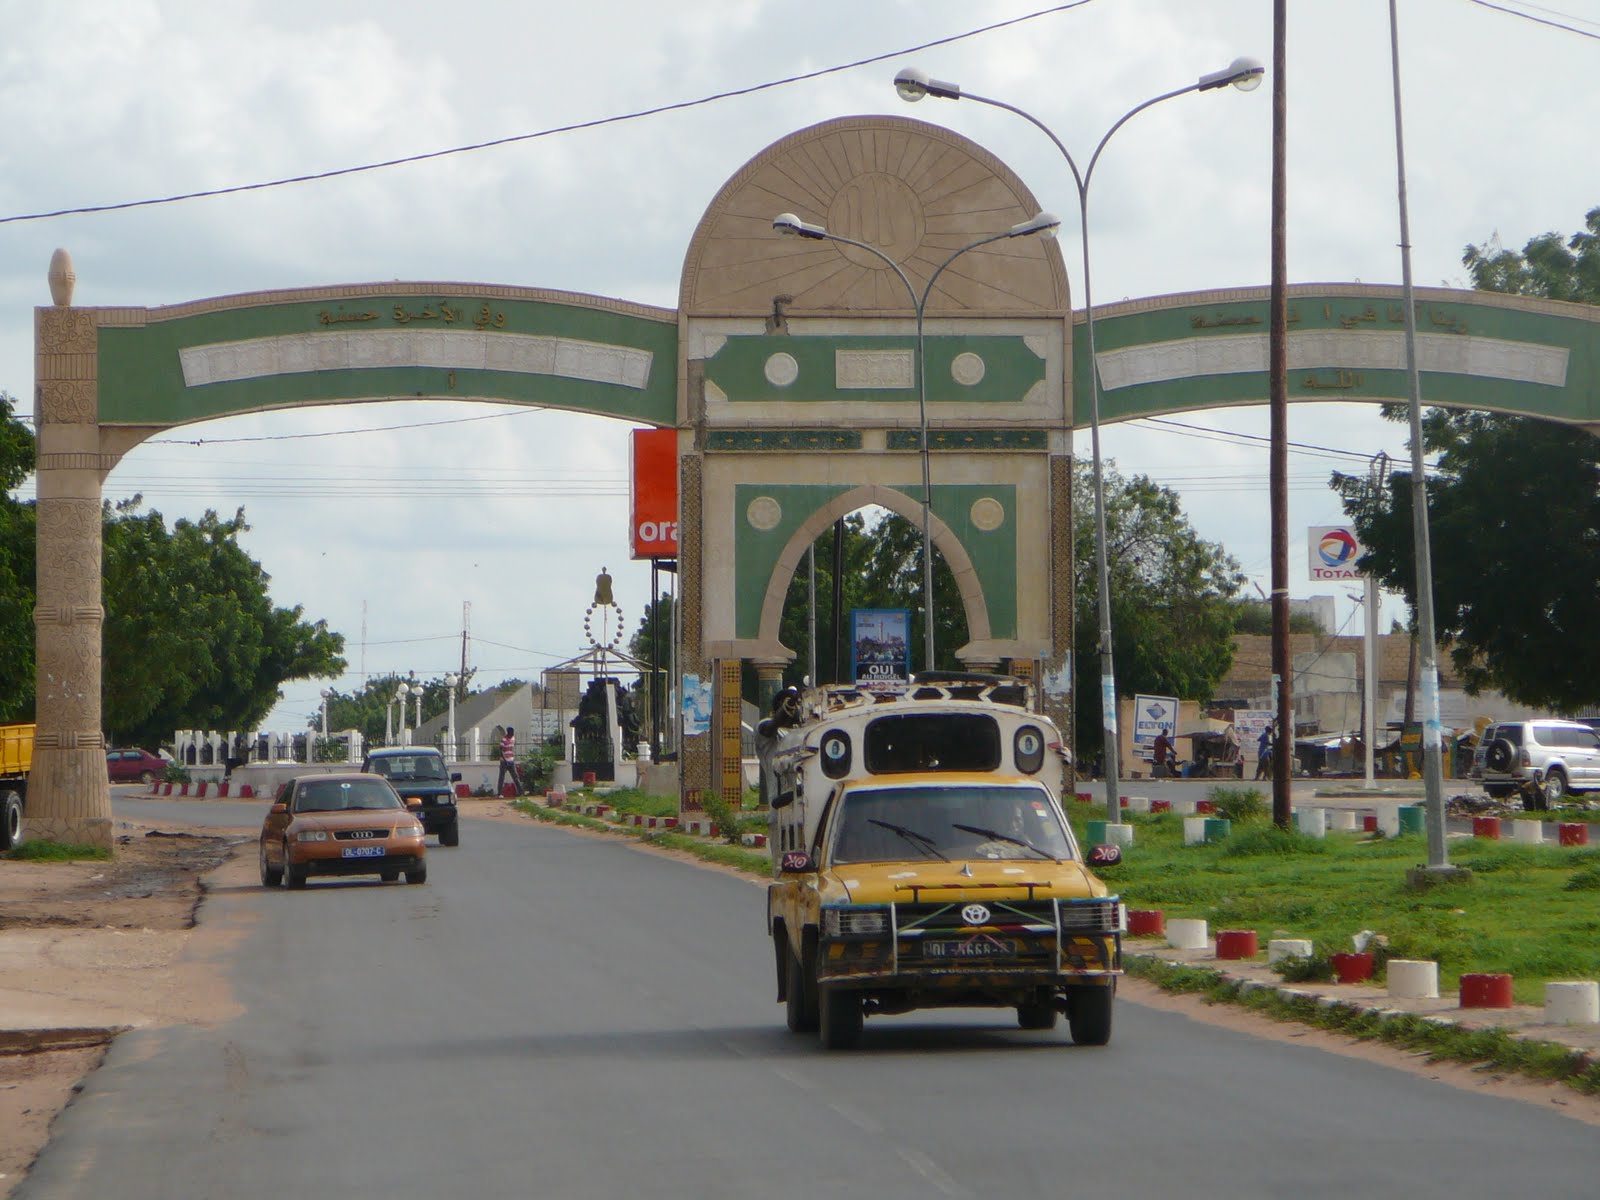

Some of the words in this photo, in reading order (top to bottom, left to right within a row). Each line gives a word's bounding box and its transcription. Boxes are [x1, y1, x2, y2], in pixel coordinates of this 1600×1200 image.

[1313, 568, 1364, 578] TOTAL
[869, 665, 893, 675] OUI
[1138, 721, 1173, 730] ELTON
[1094, 847, 1119, 861] OK
